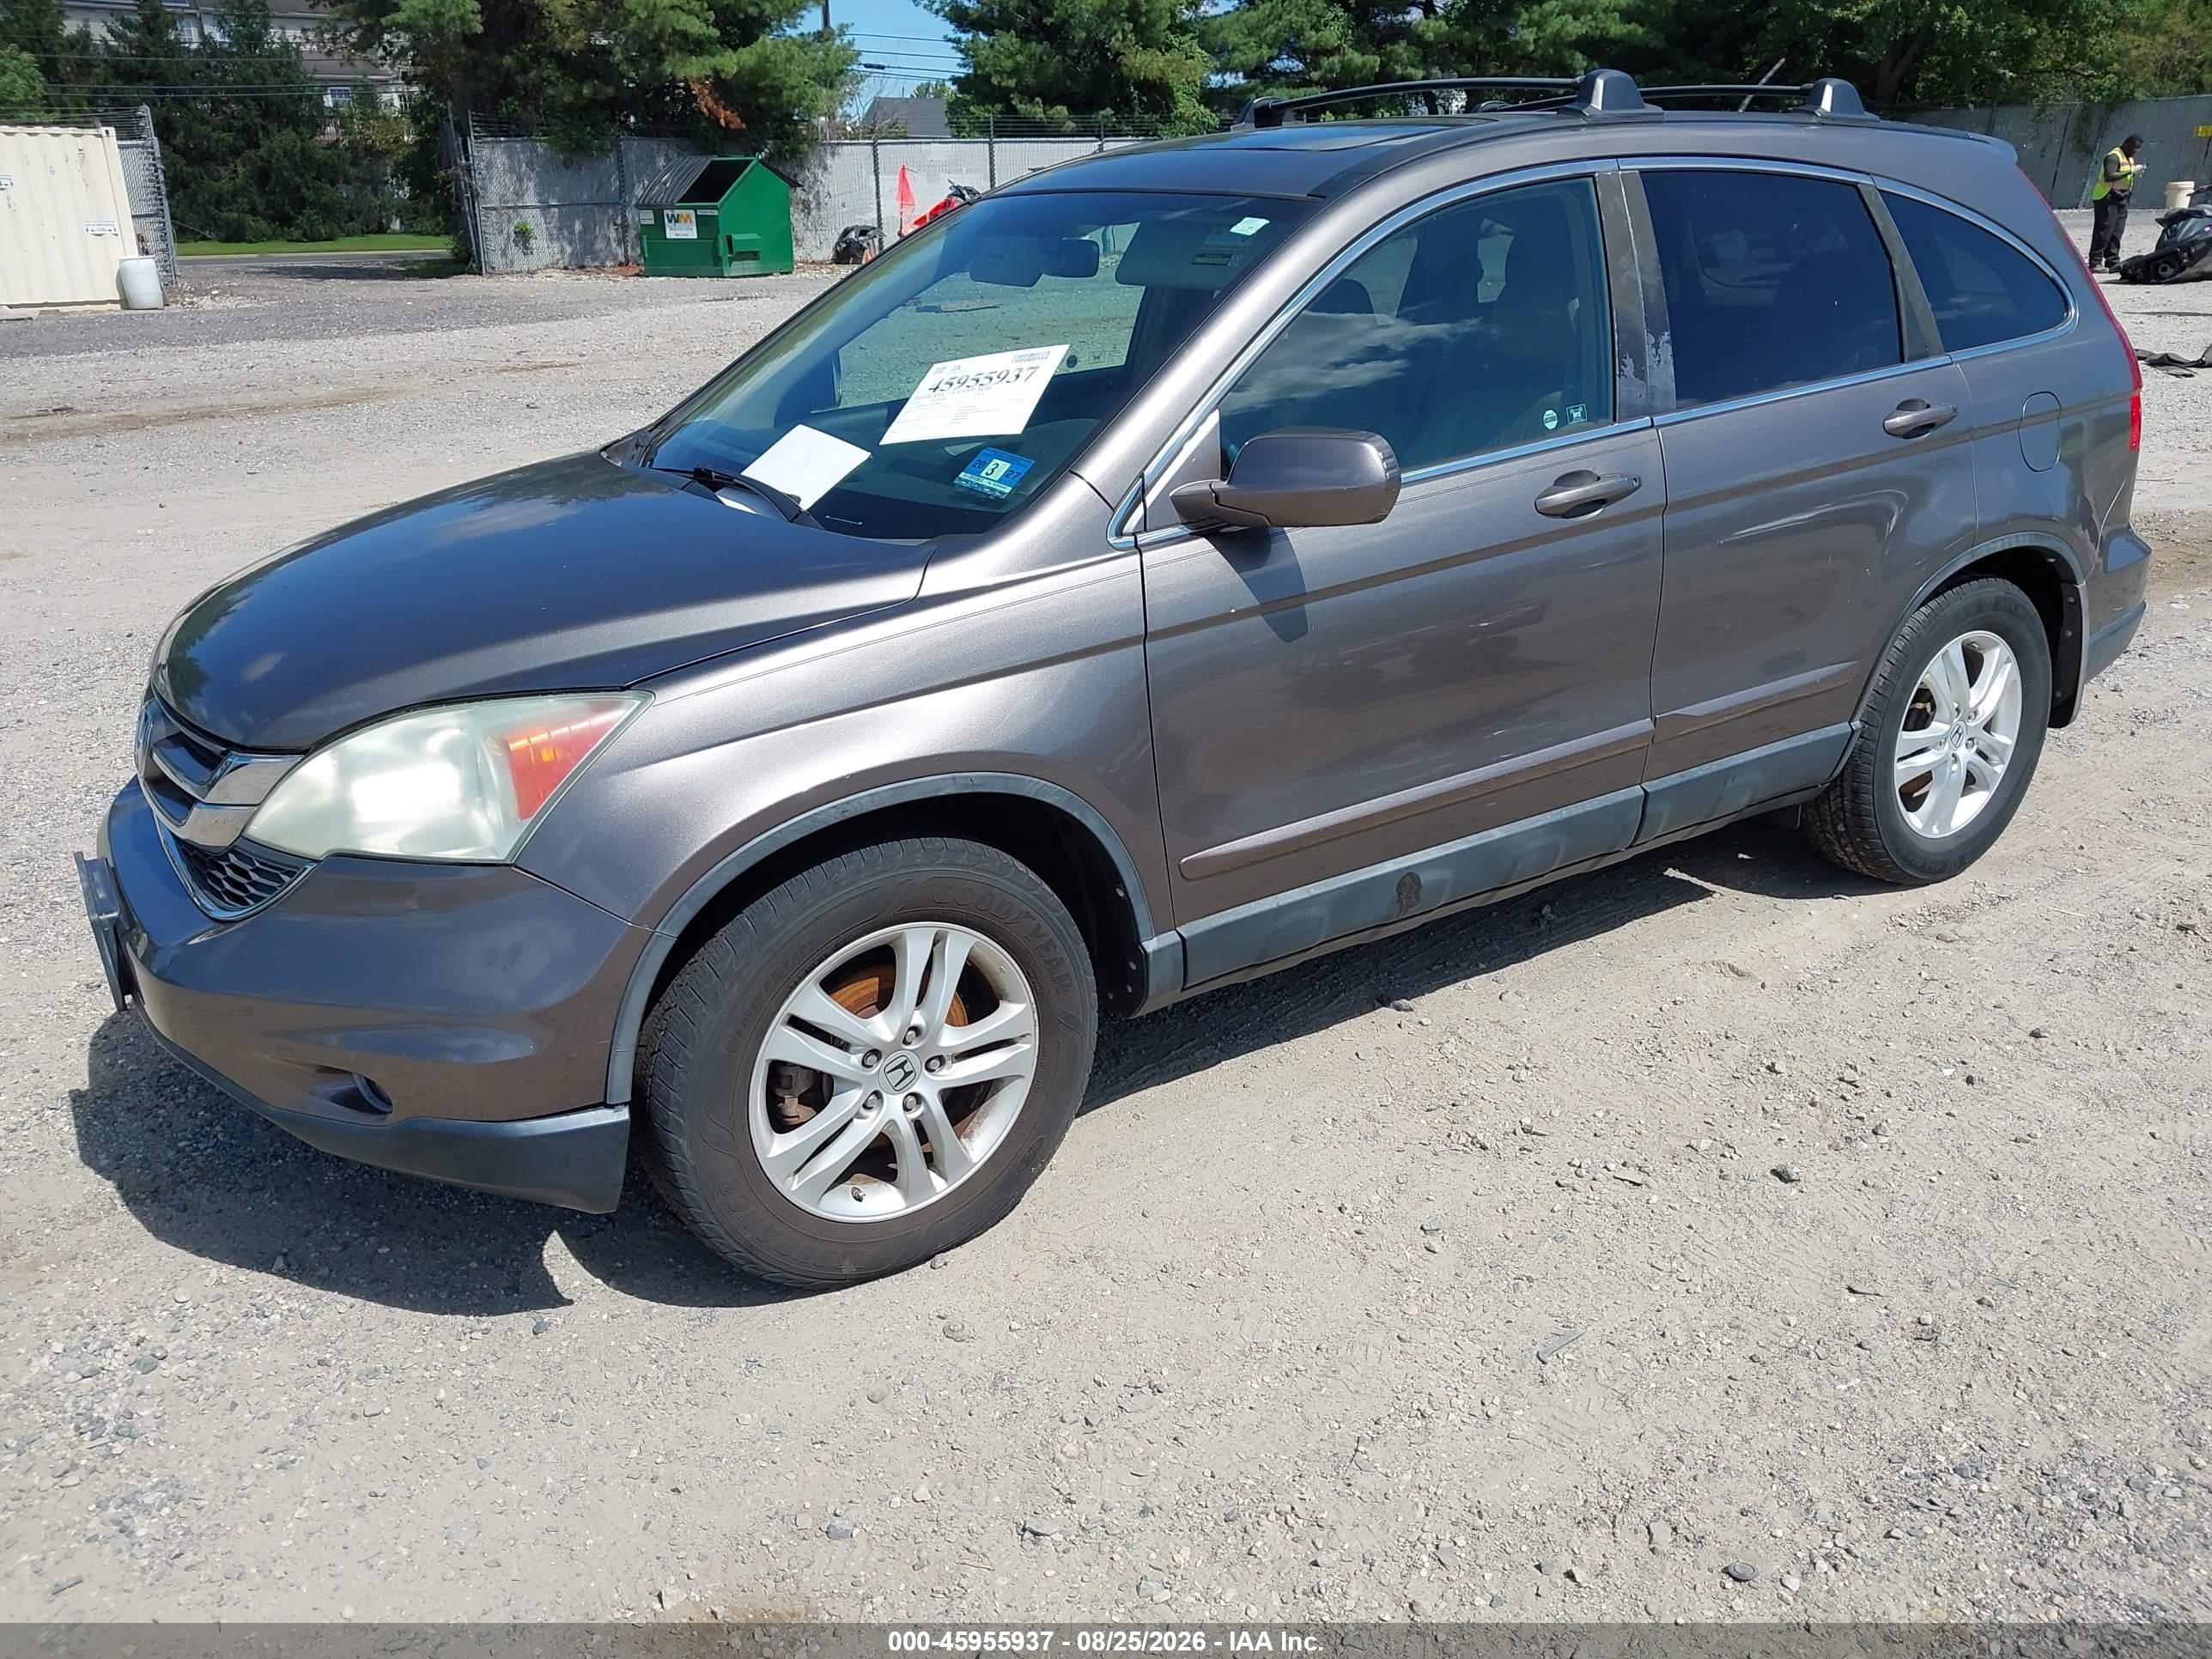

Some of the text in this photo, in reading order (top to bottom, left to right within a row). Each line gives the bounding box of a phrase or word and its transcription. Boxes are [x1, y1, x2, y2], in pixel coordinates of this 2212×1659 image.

[928, 366, 1040, 392] 45955937
[985, 462, 1000, 476] 3
[1006, 470, 1021, 479] 27
